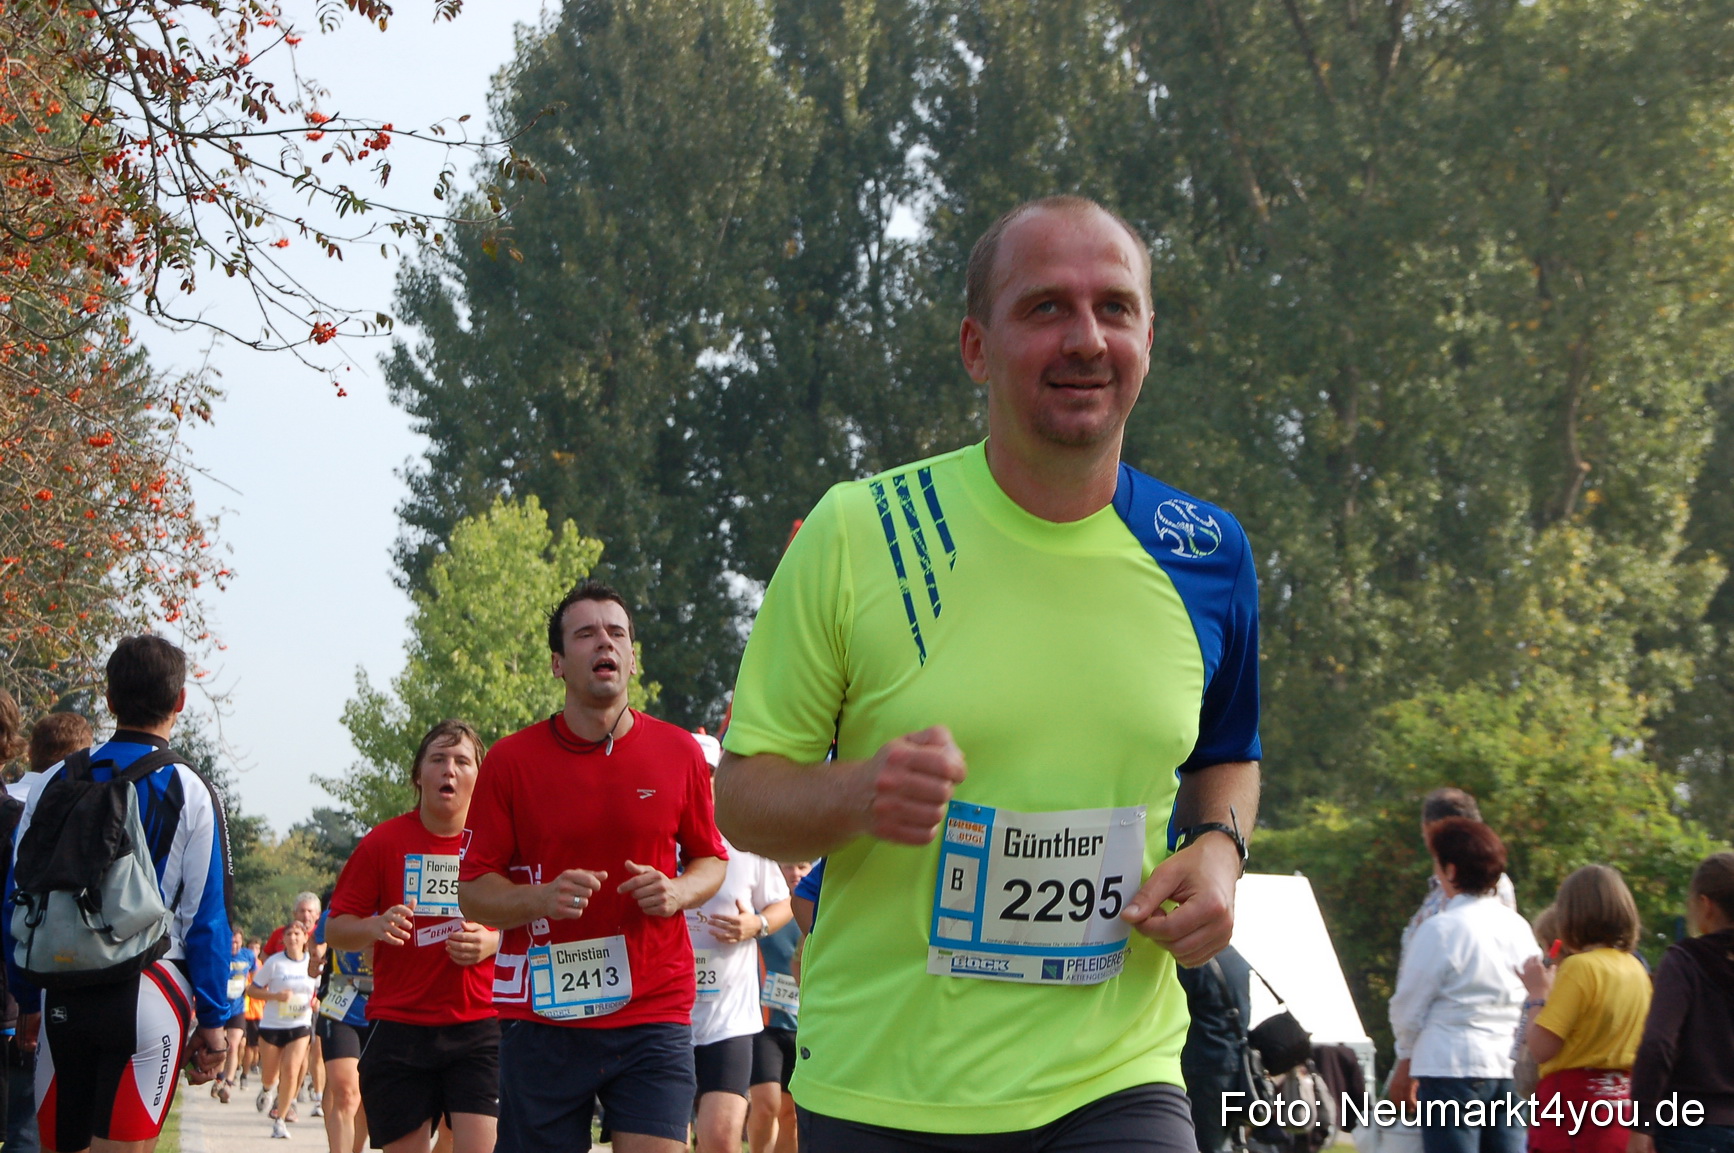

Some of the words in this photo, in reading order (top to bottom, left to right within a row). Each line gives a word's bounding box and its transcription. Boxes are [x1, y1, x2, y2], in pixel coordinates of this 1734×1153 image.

[1003, 827, 1104, 859] Günther
[426, 860, 459, 873] Florian
[408, 877, 414, 886] C
[950, 867, 964, 891] B
[999, 875, 1124, 922] 2295
[430, 925, 454, 939] DEHN
[556, 947, 610, 965] Christian
[1067, 950, 1127, 972] PFLEIDERE
[561, 966, 620, 993] 2413
